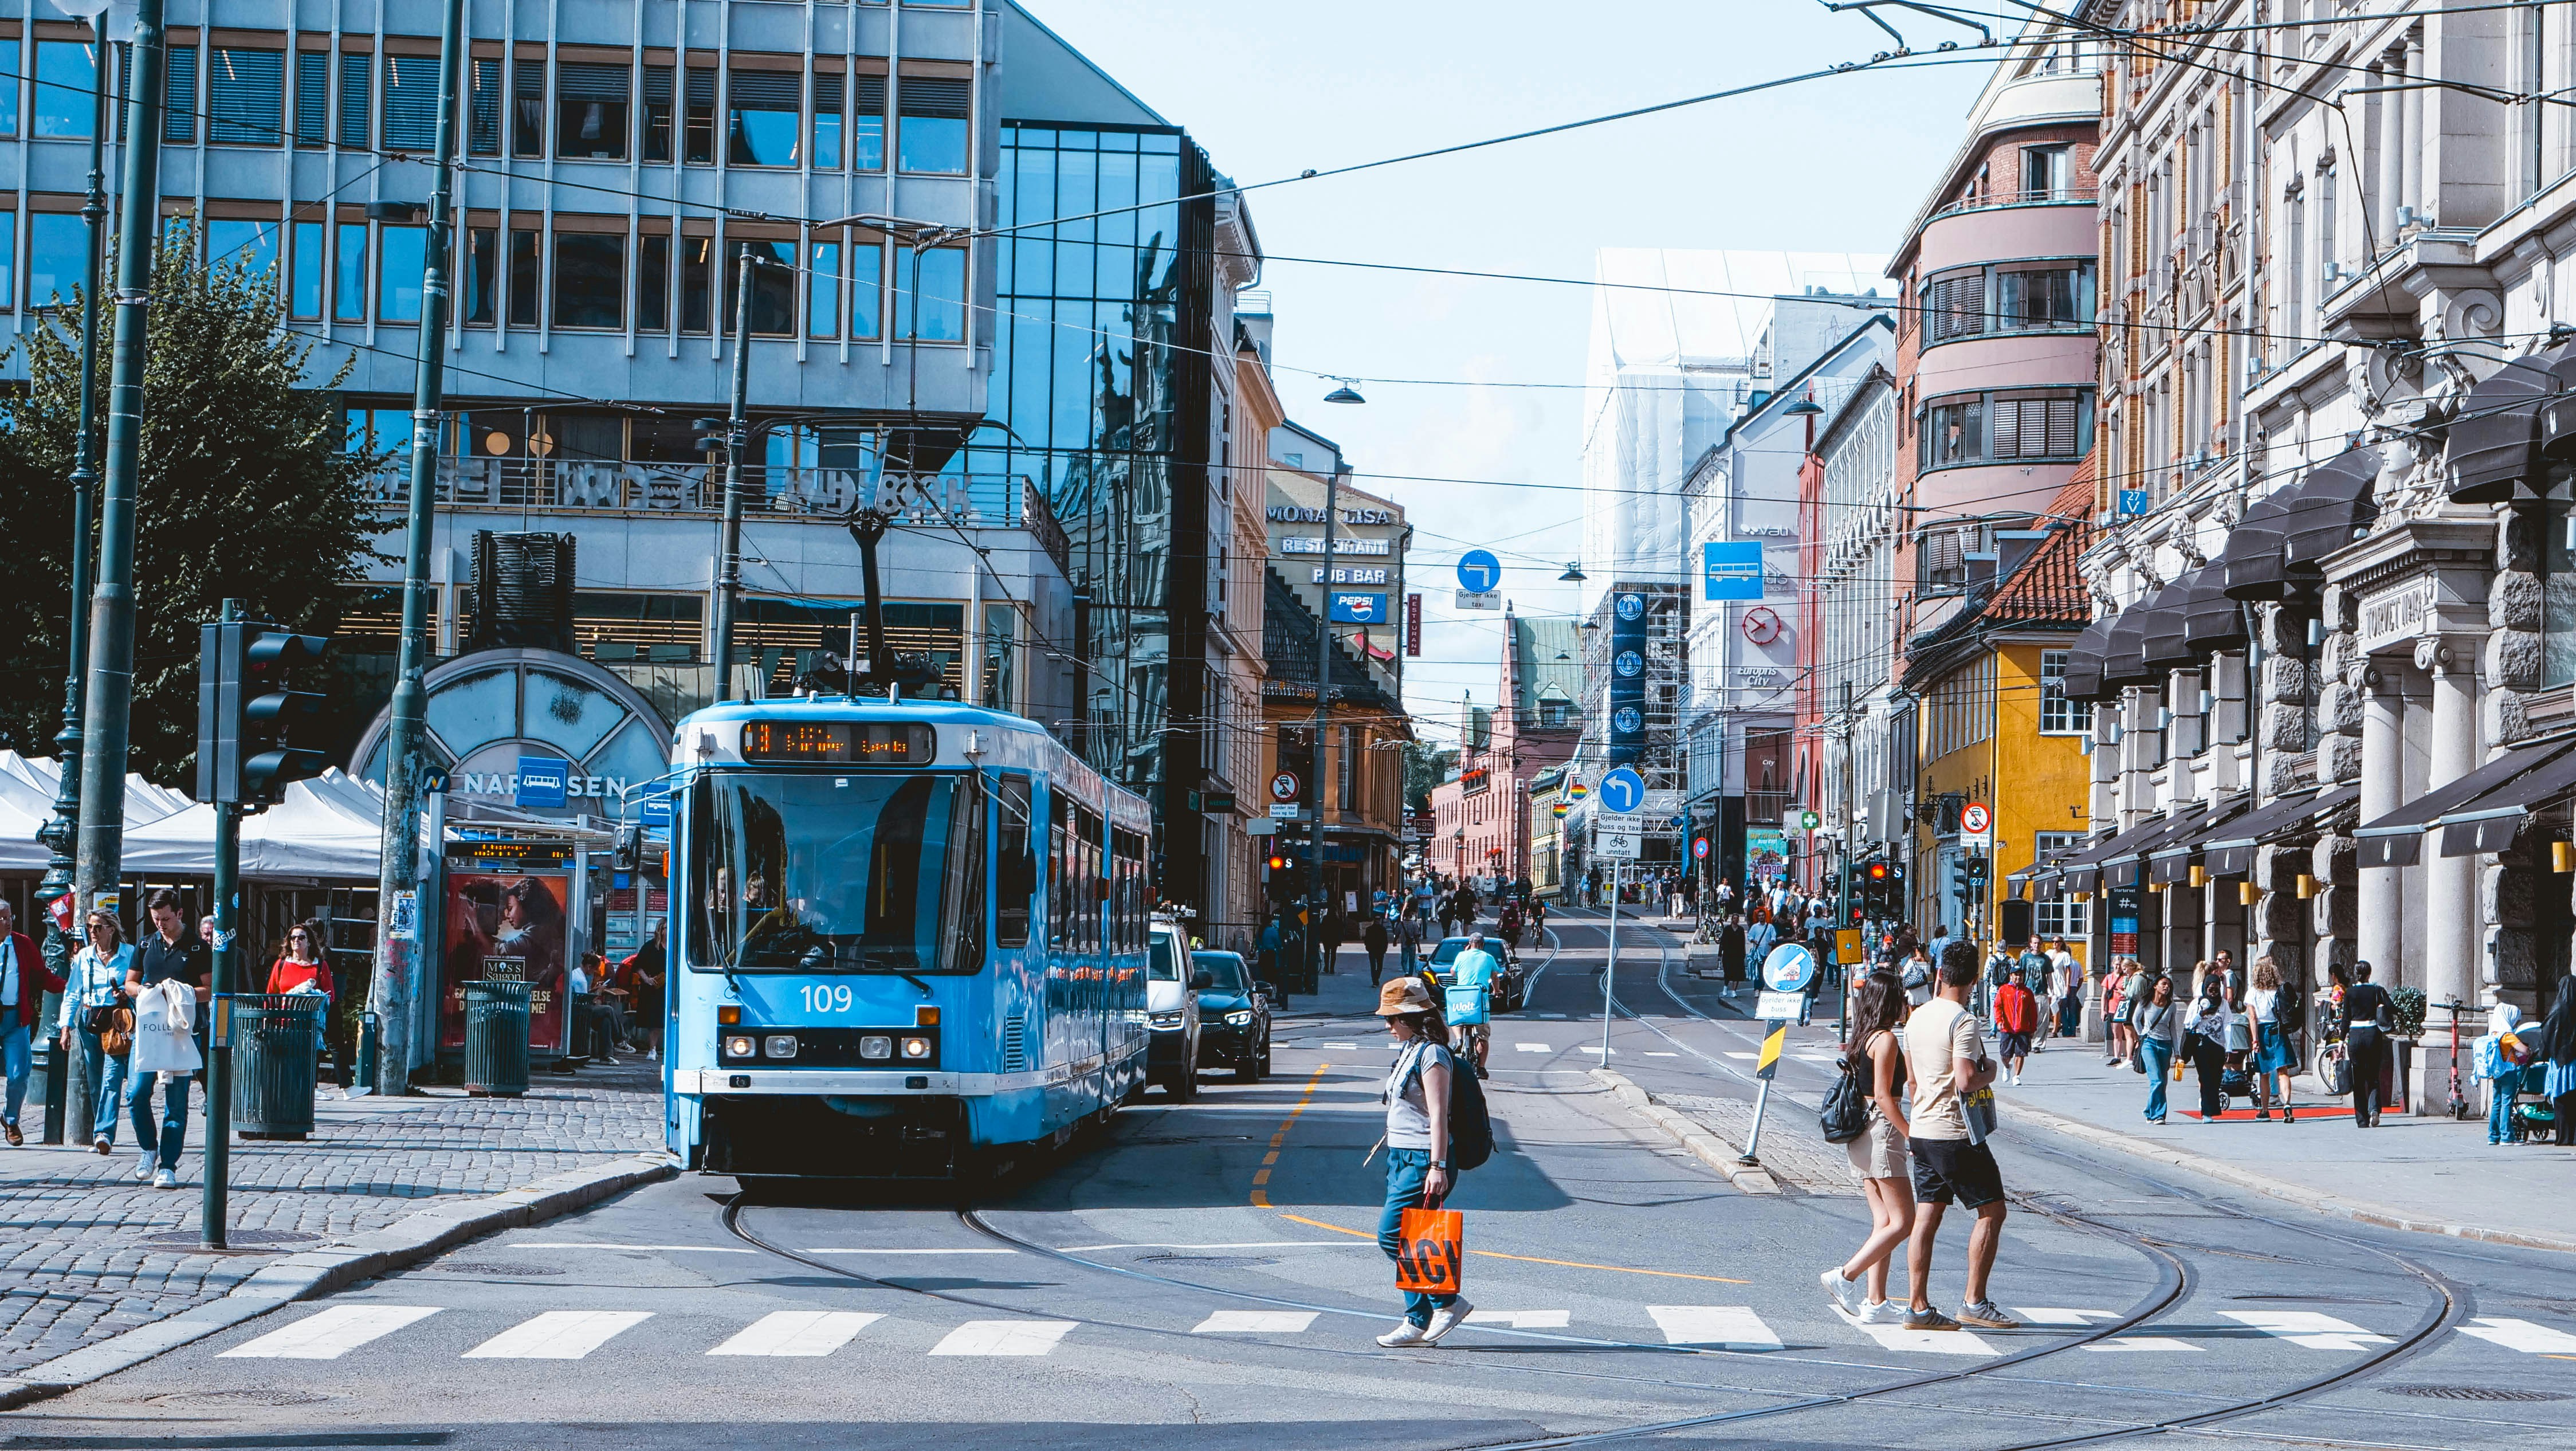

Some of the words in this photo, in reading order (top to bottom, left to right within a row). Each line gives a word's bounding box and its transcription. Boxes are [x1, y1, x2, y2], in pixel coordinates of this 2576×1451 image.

[2127, 491, 2141, 501] 27
[1343, 508, 1389, 524] LISA
[1283, 538, 1384, 554] RESTURANT
[1314, 568, 1346, 583] PUB
[1353, 569, 1385, 583] BAR
[1338, 596, 1373, 606] PEPSI
[1737, 666, 1777, 678] Europris
[1746, 676, 1769, 687] City
[464, 772, 626, 797] NASEN
[1601, 814, 1625, 822] Gjelder
[1285, 858, 1292, 868] S
[1894, 866, 1902, 878] S
[1972, 878, 1983, 886] 27
[486, 972, 521, 981] Saigon
[531, 990, 551, 1002] ELSE
[800, 985, 853, 1013] 109
[1452, 1001, 1475, 1012] Wolt
[143, 1023, 171, 1032] FOLLE
